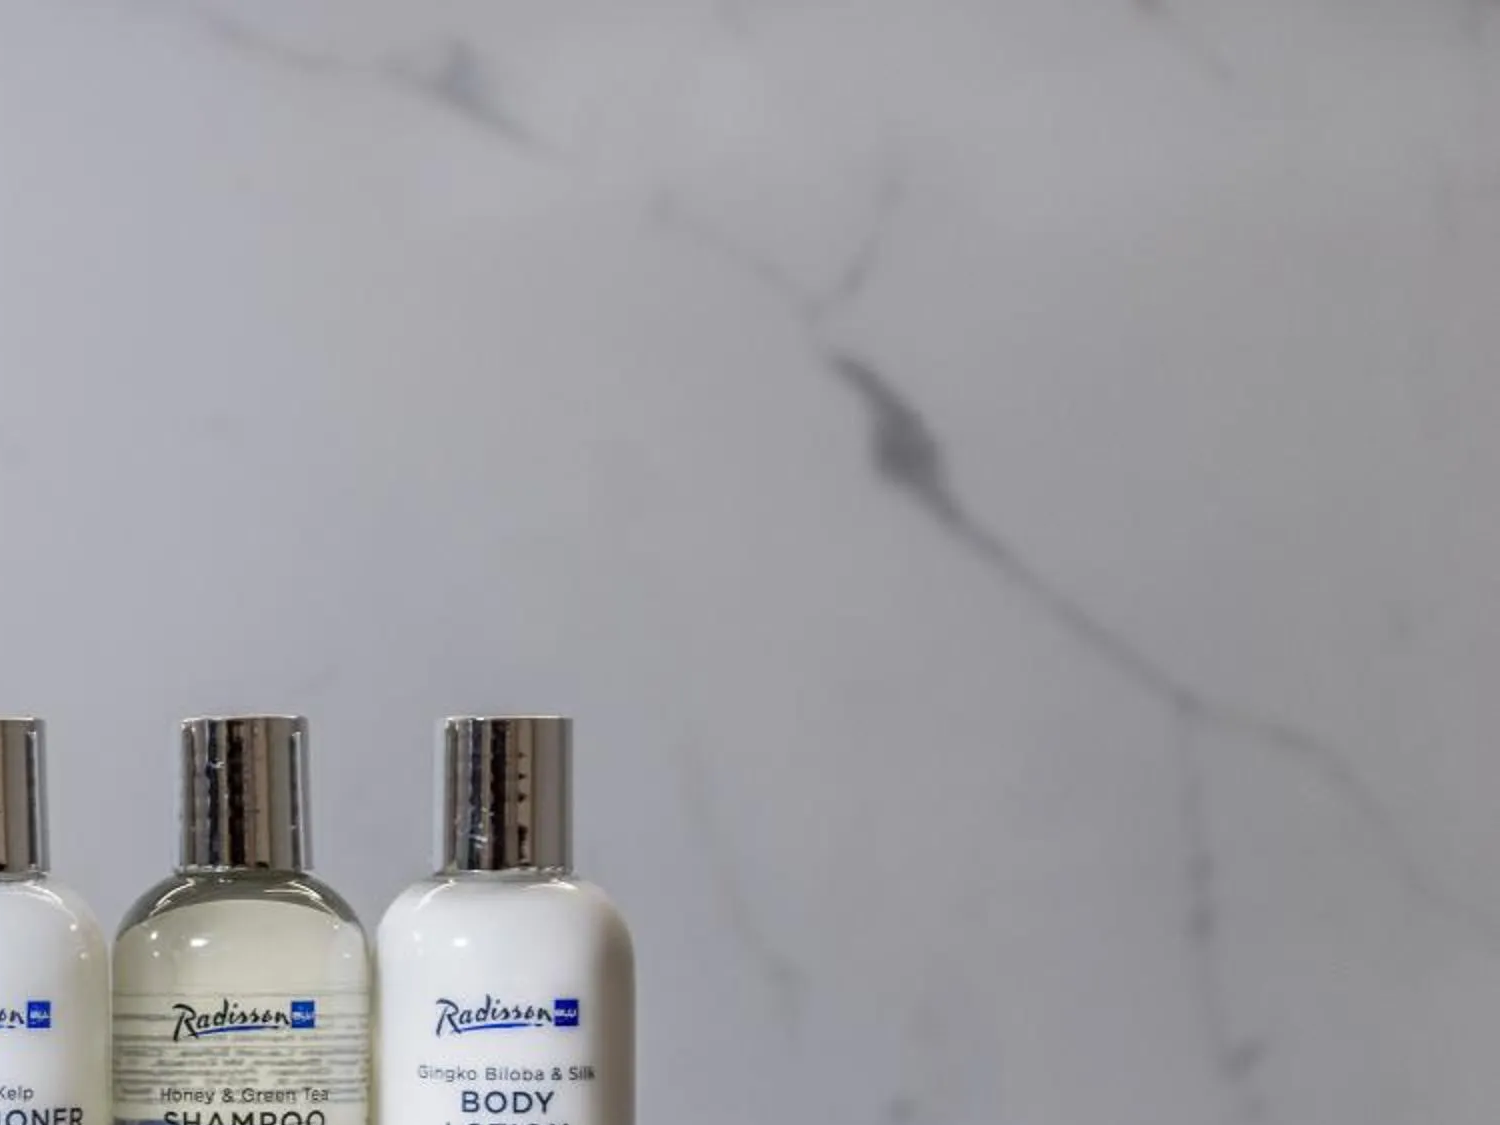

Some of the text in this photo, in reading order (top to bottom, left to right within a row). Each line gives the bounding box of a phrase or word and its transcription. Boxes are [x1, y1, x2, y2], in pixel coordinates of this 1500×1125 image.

[172, 998, 290, 1042] Radisson
[435, 993, 553, 1039] Radisson
[418, 1064, 596, 1083] Gingko Biloba & Silk
[160, 1087, 330, 1105] Honey & Green Tea
[461, 1090, 555, 1114] BODY
